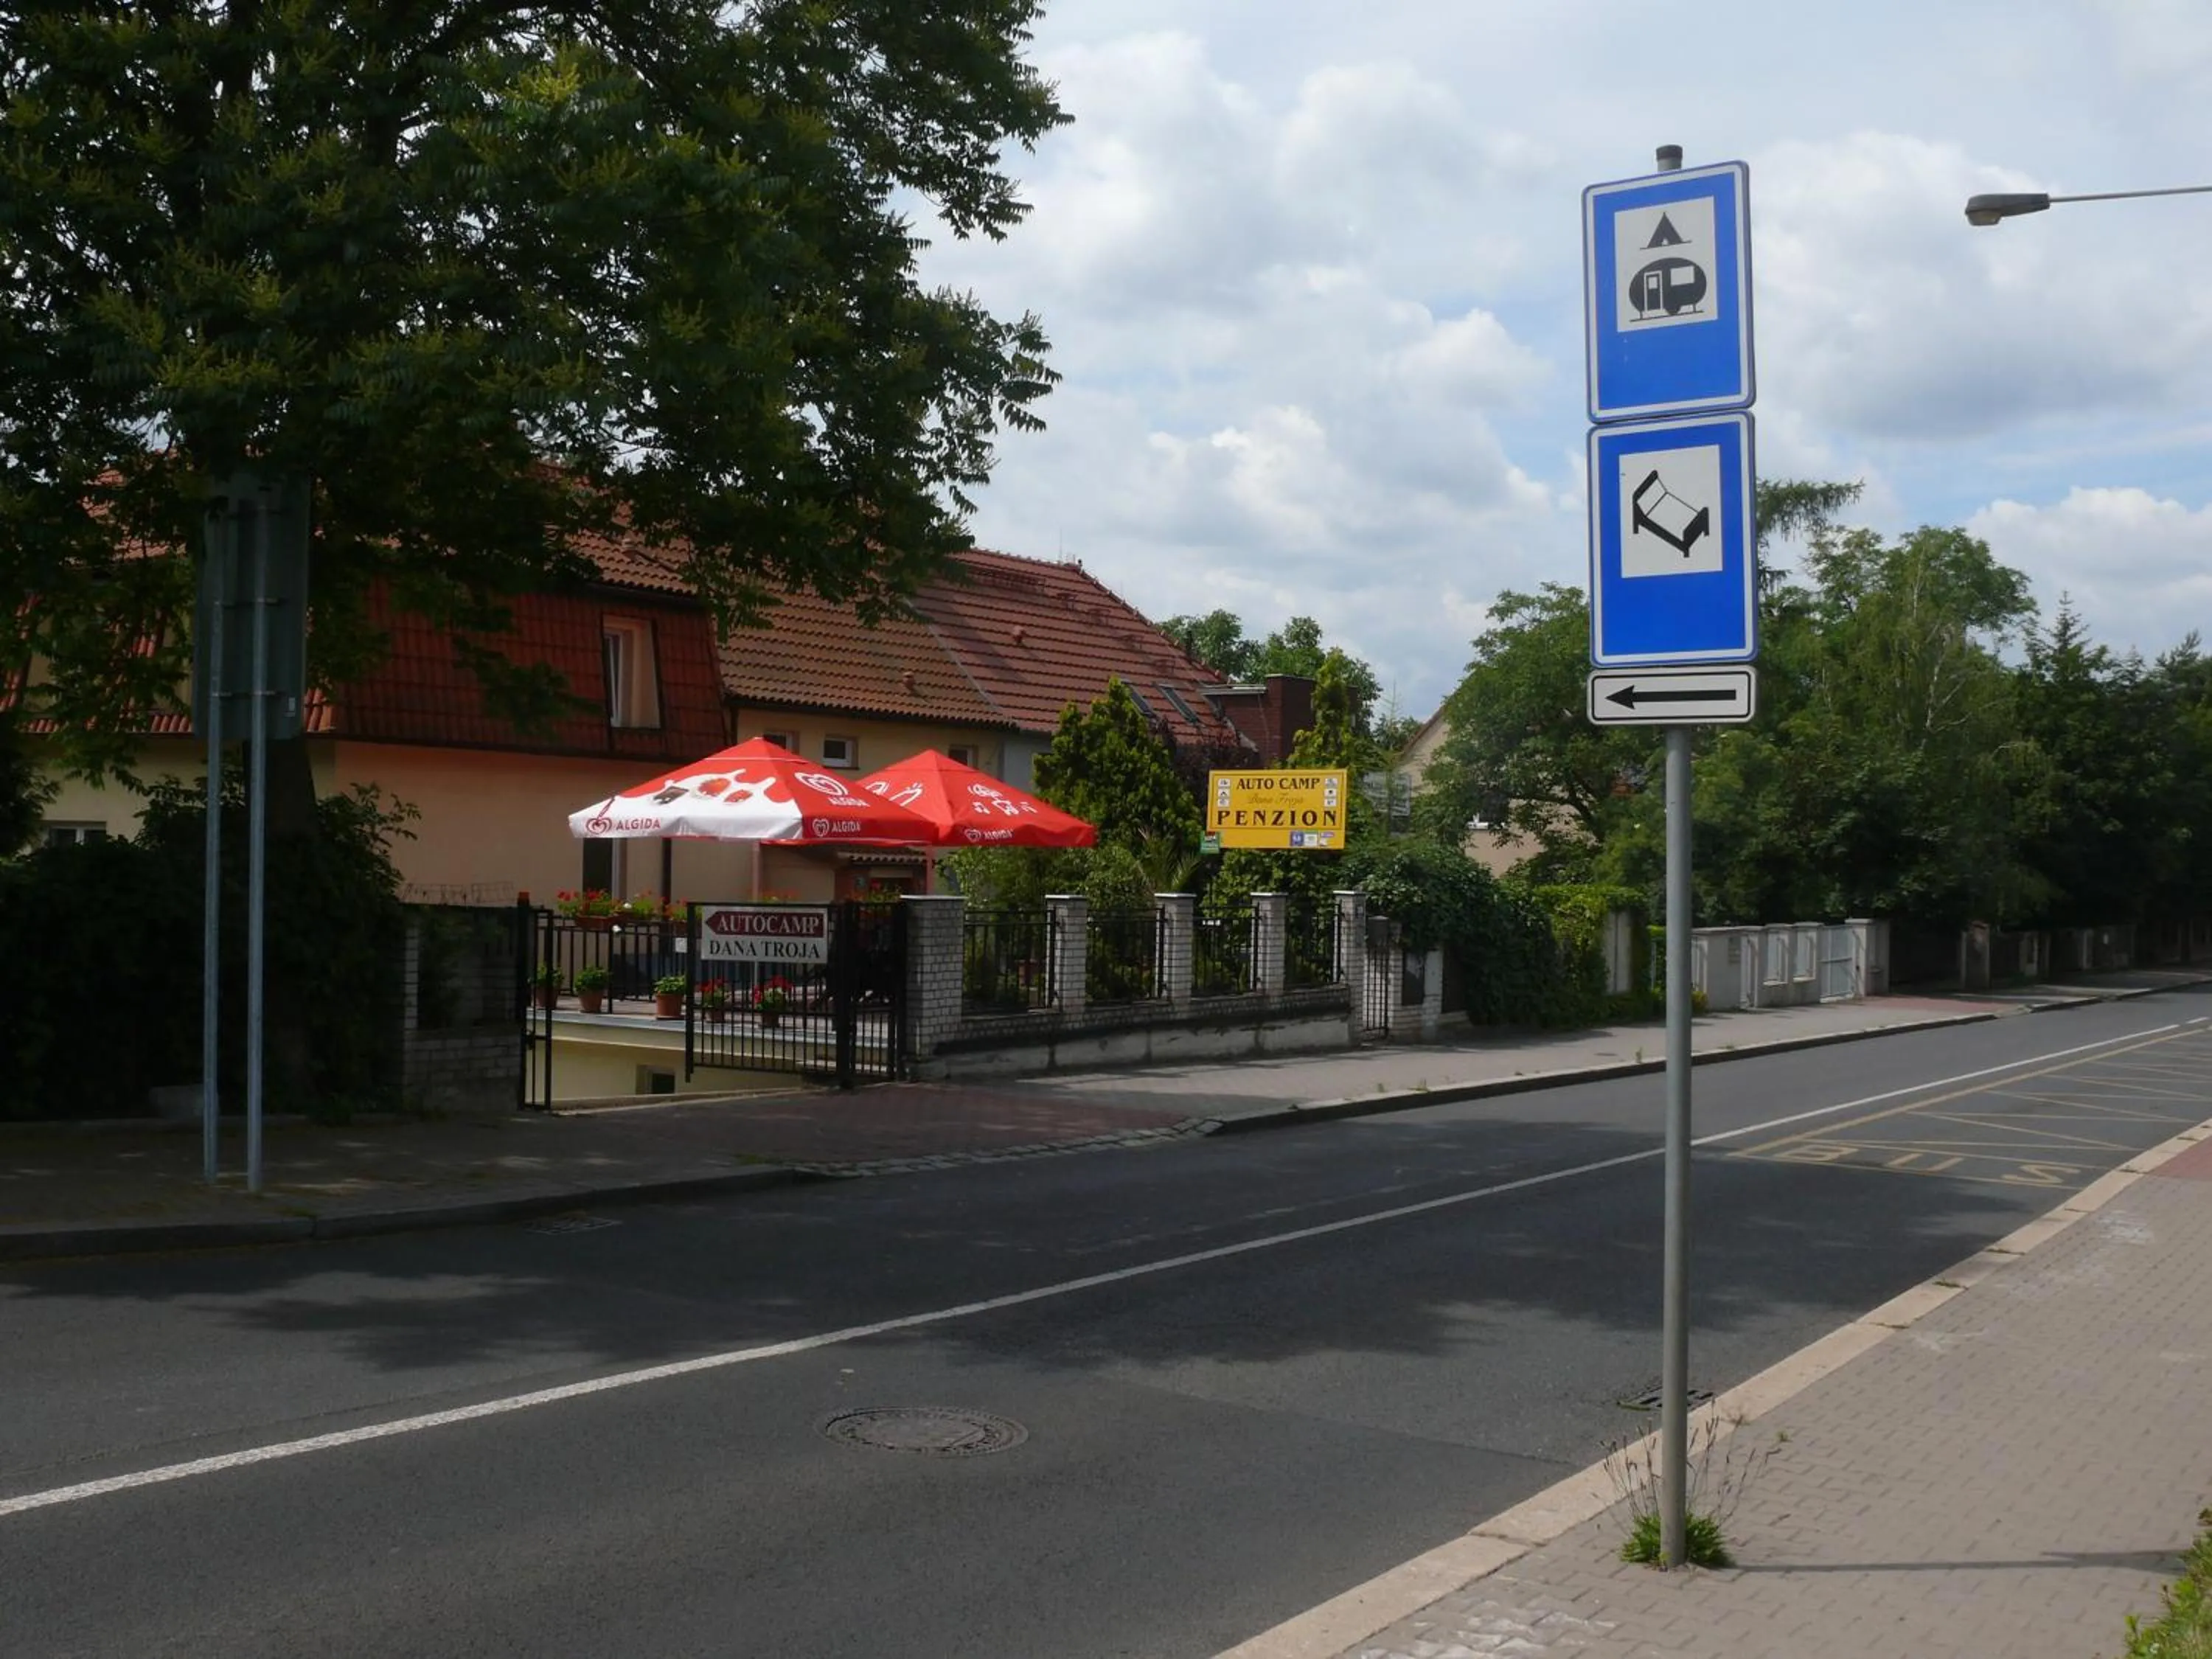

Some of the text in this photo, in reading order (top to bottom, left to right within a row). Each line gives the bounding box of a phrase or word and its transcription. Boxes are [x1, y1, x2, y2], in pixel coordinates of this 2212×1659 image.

[1237, 778, 1320, 790] AUTO CAMP
[616, 818, 661, 831] ALGIDA
[1217, 810, 1336, 826] PENZION
[831, 820, 861, 832] ALGIDA
[717, 914, 819, 934] AUTOCAMP
[709, 939, 820, 959] DANA TROJA
